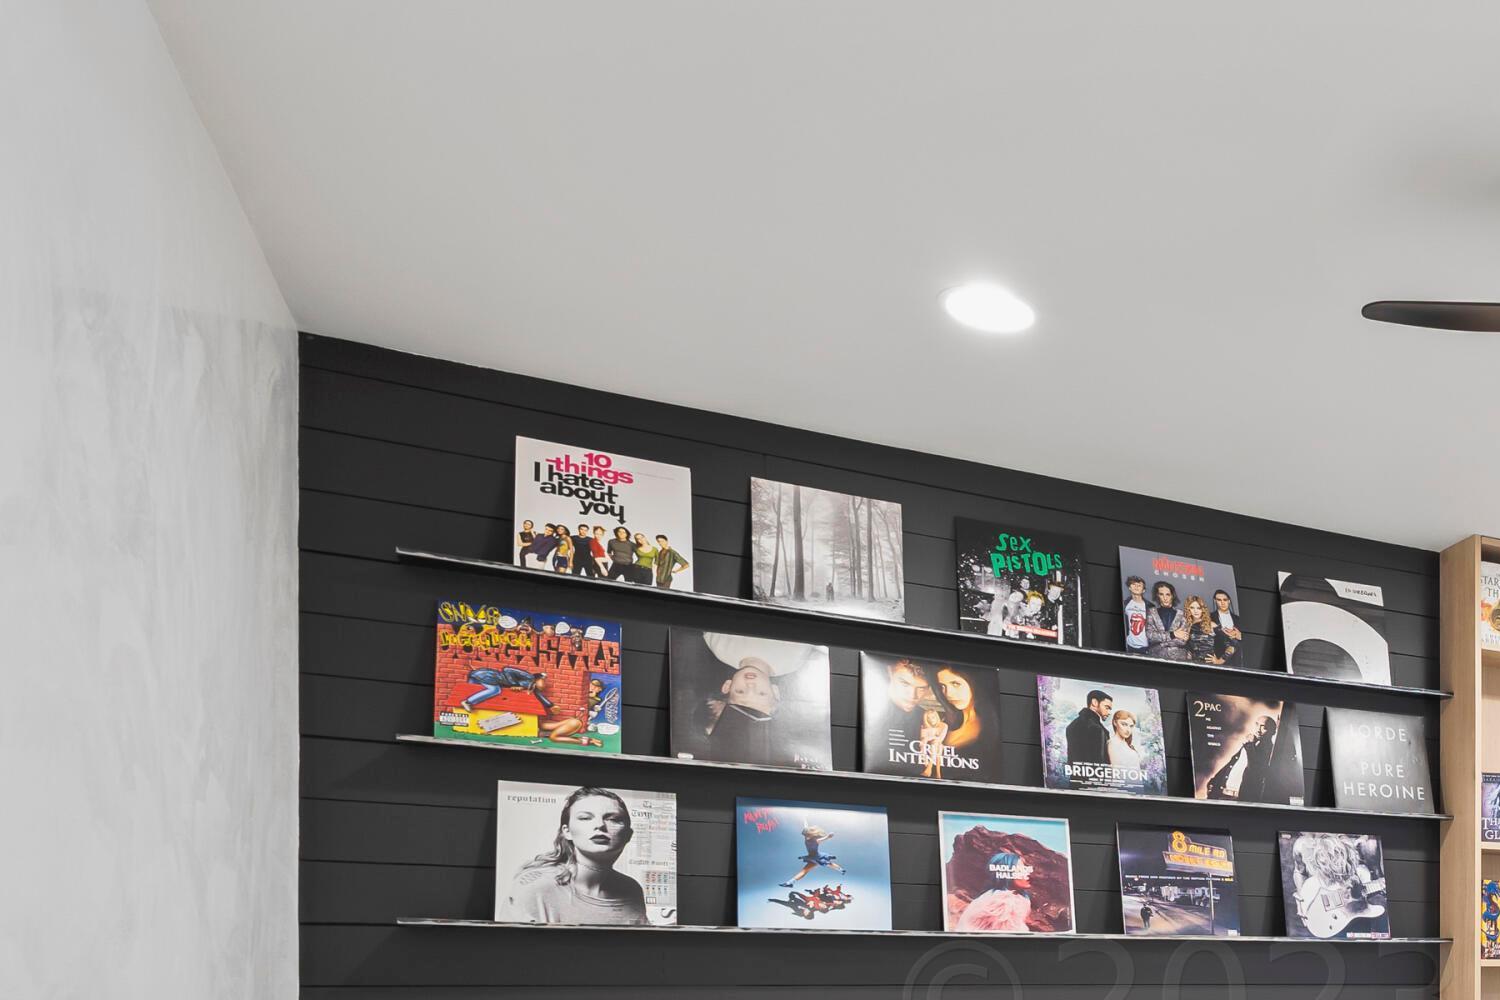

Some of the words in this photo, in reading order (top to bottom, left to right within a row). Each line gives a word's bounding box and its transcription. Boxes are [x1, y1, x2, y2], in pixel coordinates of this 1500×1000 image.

[583, 452, 613, 468] 10
[534, 461, 541, 482] I
[548, 464, 605, 491] hate
[546, 454, 634, 485] things
[539, 480, 619, 505] about
[579, 500, 625, 525] you
[1193, 700, 1222, 717] 2PAC
[908, 740, 959, 757] CRUEL
[888, 748, 980, 770] INTENTIONS
[1064, 764, 1148, 781] BRIDGERTON
[1360, 761, 1405, 778] PURE
[507, 794, 557, 804] reputation
[1343, 781, 1425, 801] HEROINE
[1172, 830, 1188, 853] 8
[1189, 845, 1211, 856] MILE
[989, 864, 1034, 874] BADLANDS
